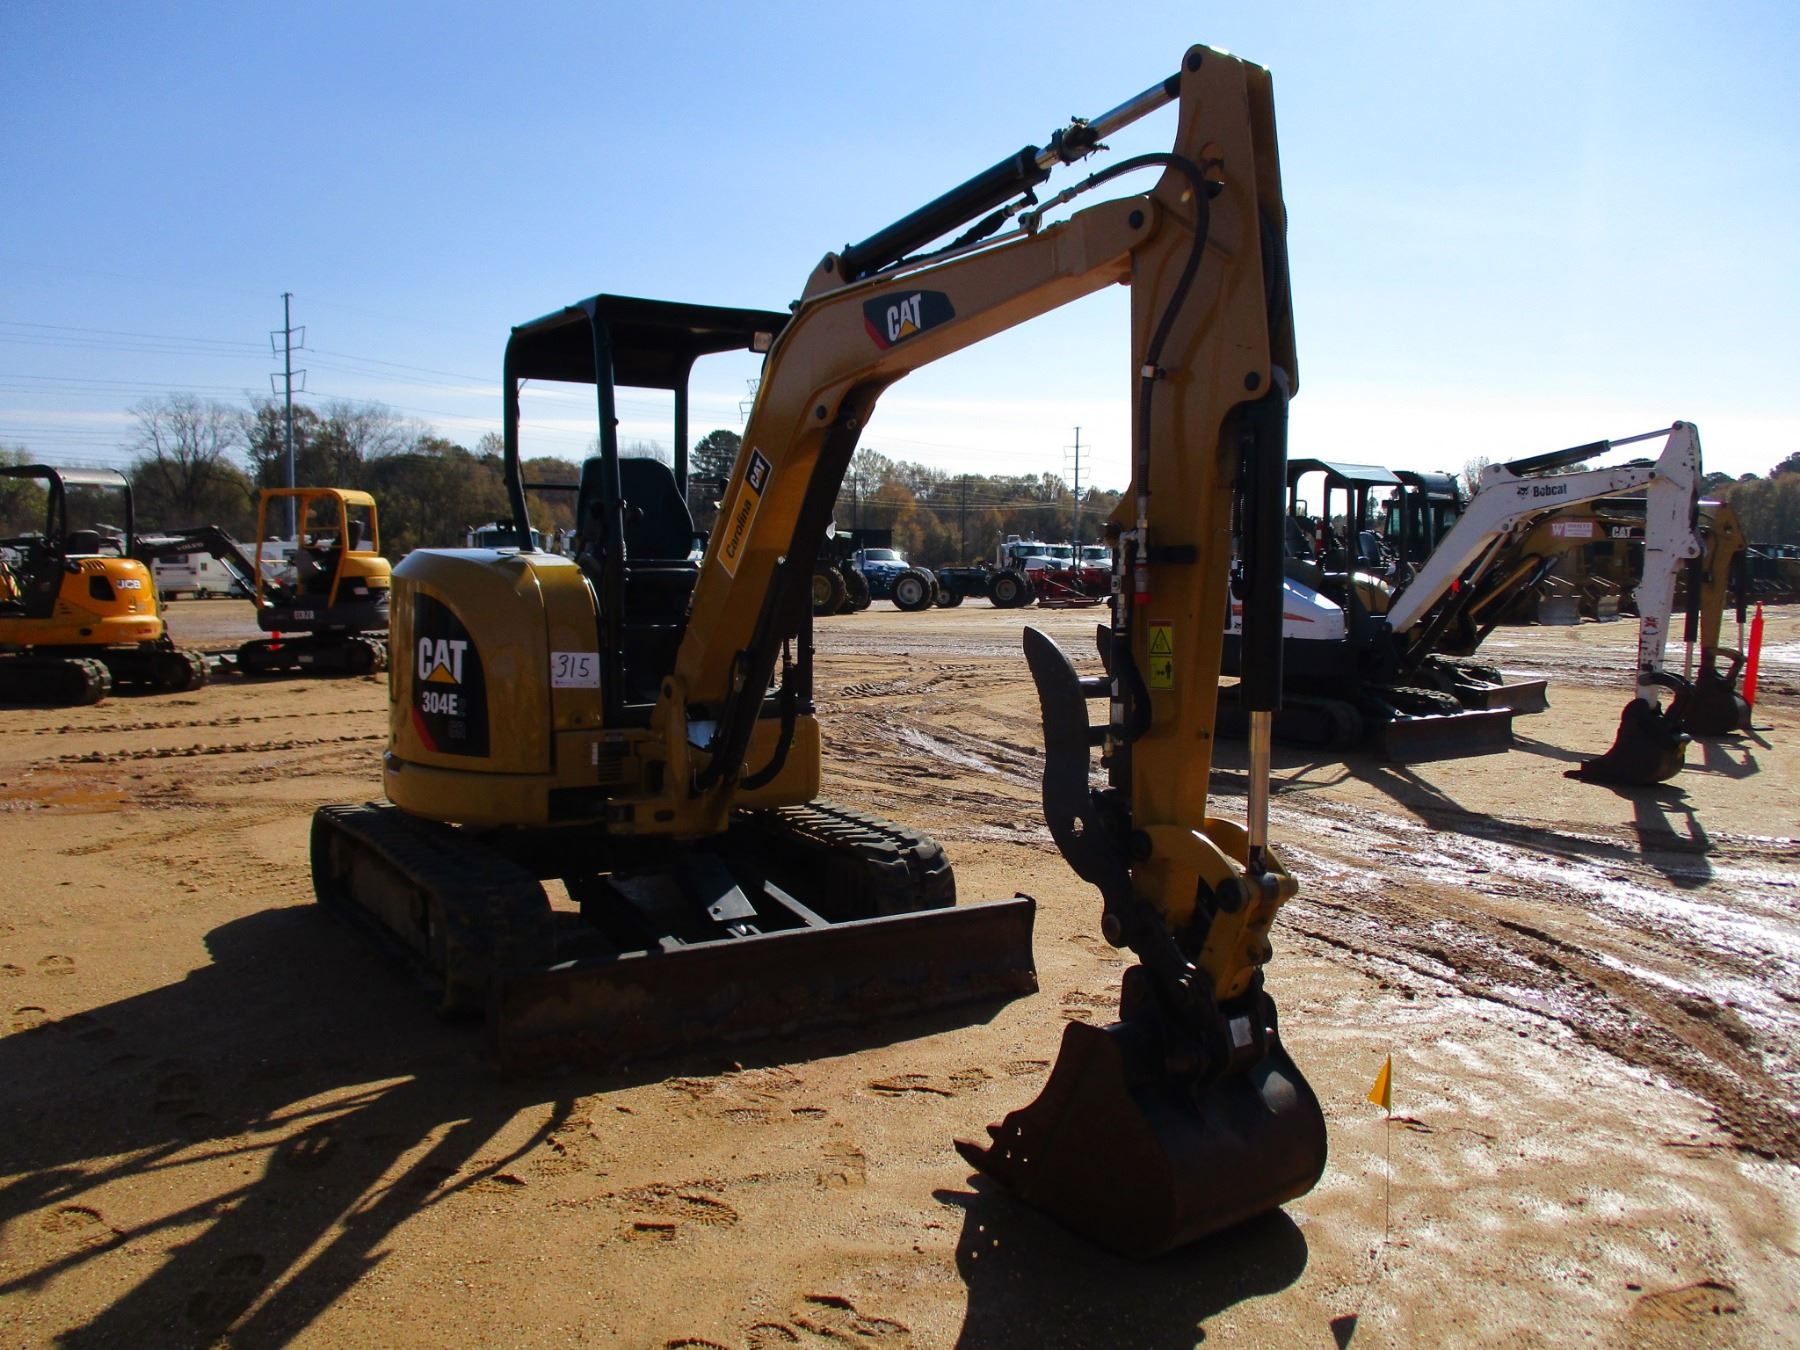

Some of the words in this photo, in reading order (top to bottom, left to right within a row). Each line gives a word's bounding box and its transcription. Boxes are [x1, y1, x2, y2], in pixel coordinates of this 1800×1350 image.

[887, 292, 922, 342] CAT
[1533, 483, 1568, 498] Bobcat
[725, 499, 753, 559] Carolina
[750, 457, 766, 489] CAT
[1611, 526, 1633, 539] CAT
[116, 579, 142, 590] JCB
[418, 636, 468, 685] CAT
[556, 654, 591, 679] 315
[422, 690, 459, 716] 304E
